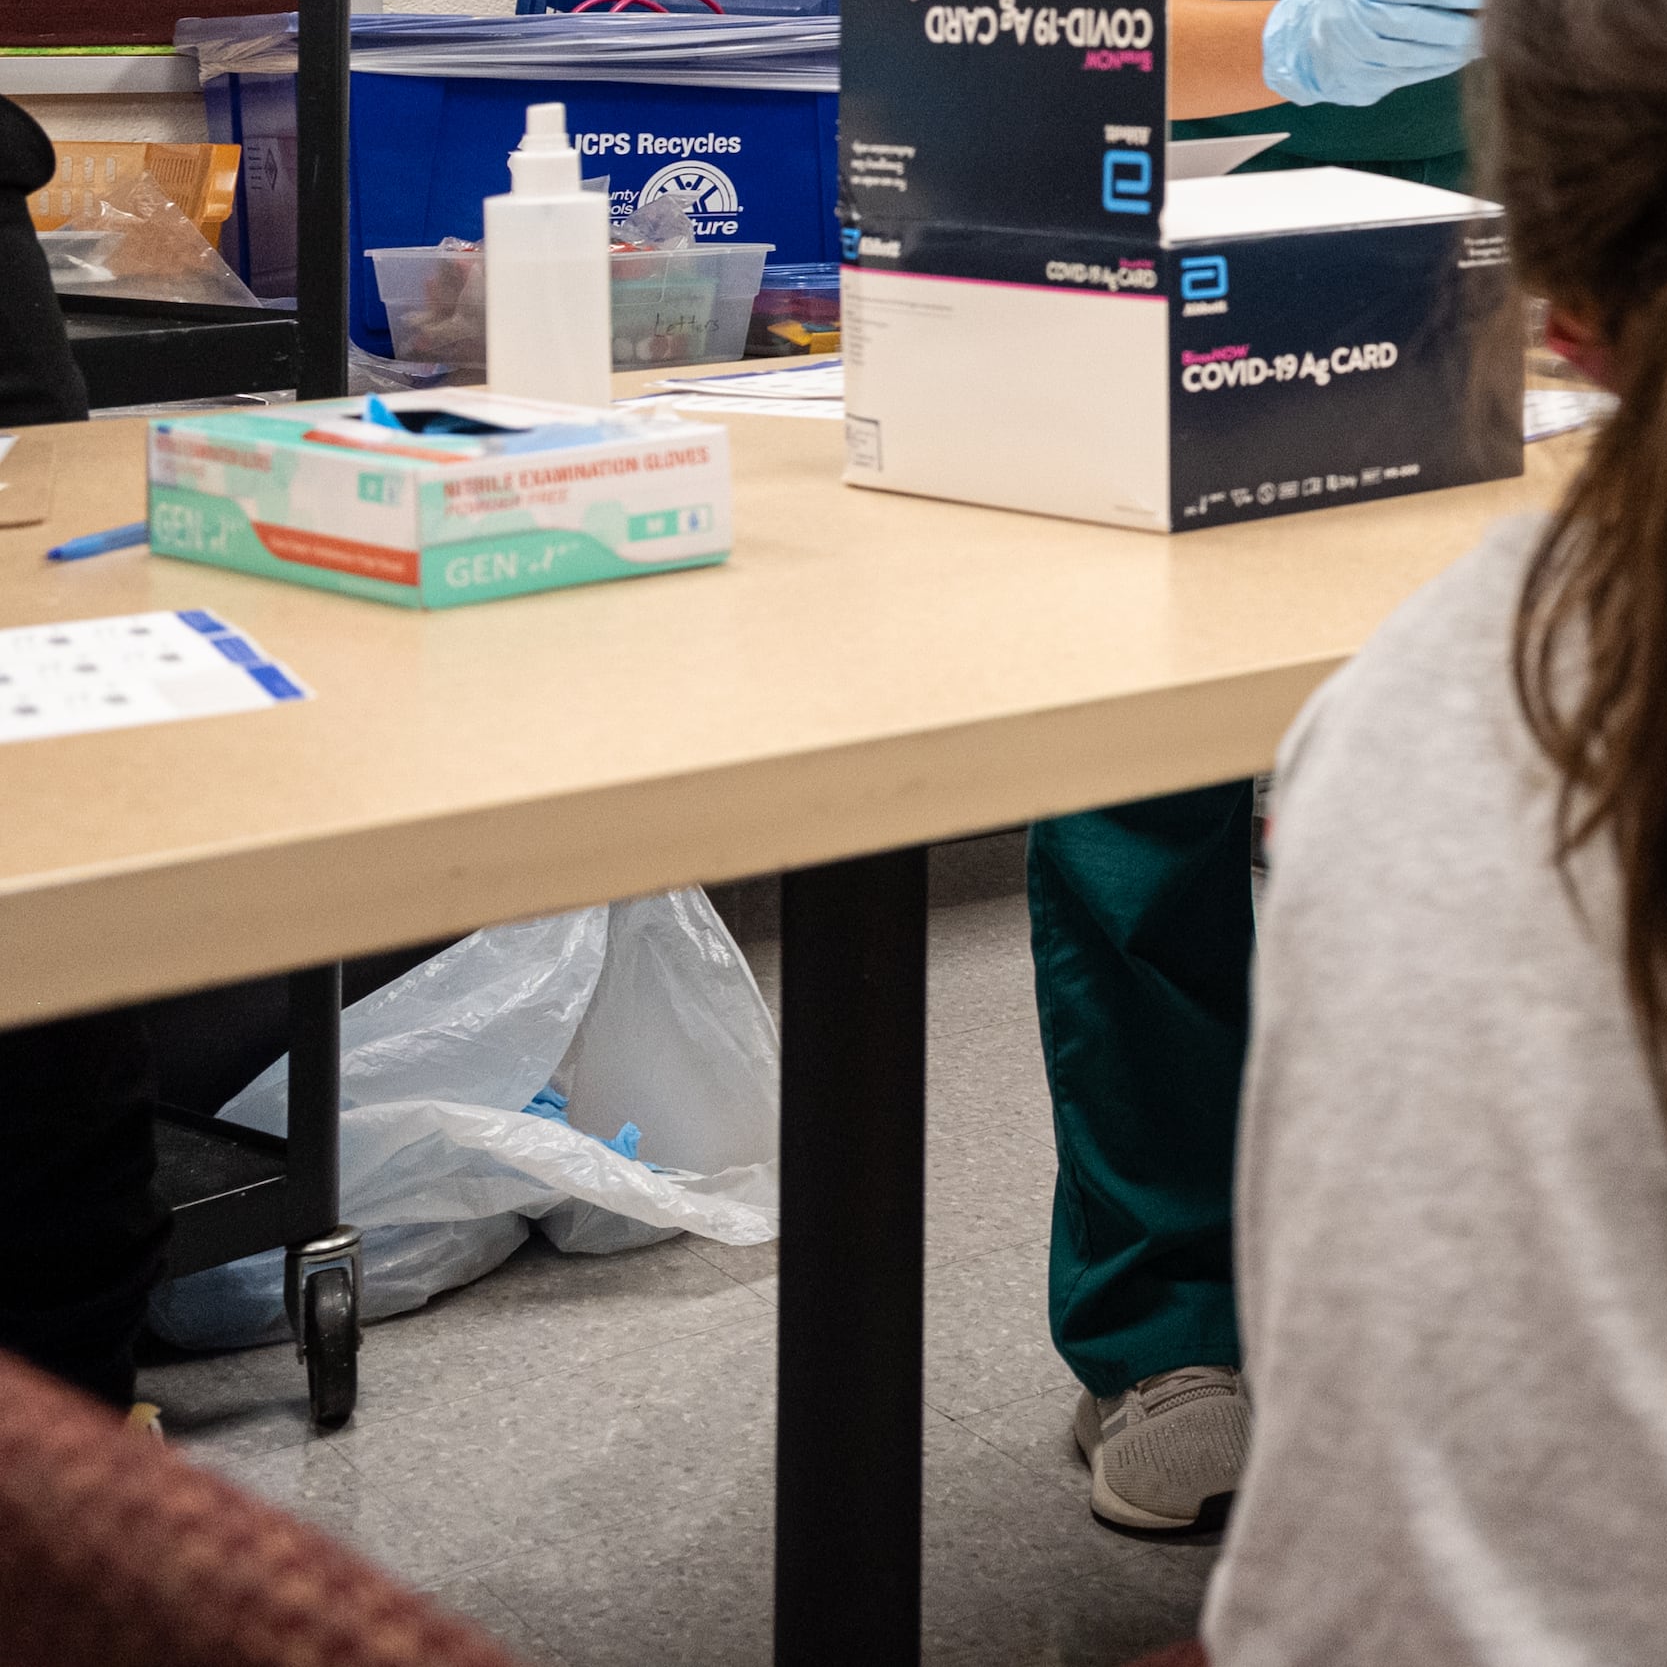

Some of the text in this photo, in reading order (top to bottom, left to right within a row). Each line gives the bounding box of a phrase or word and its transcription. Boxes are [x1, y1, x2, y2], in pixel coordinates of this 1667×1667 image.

[925, 6, 998, 45] CARD
[1035, 8, 1153, 48] COVID-19
[573, 133, 742, 158] JCPS Recycles
[1182, 342, 1398, 392] COVID-19 Ag CARD
[645, 446, 710, 472] GLOVES
